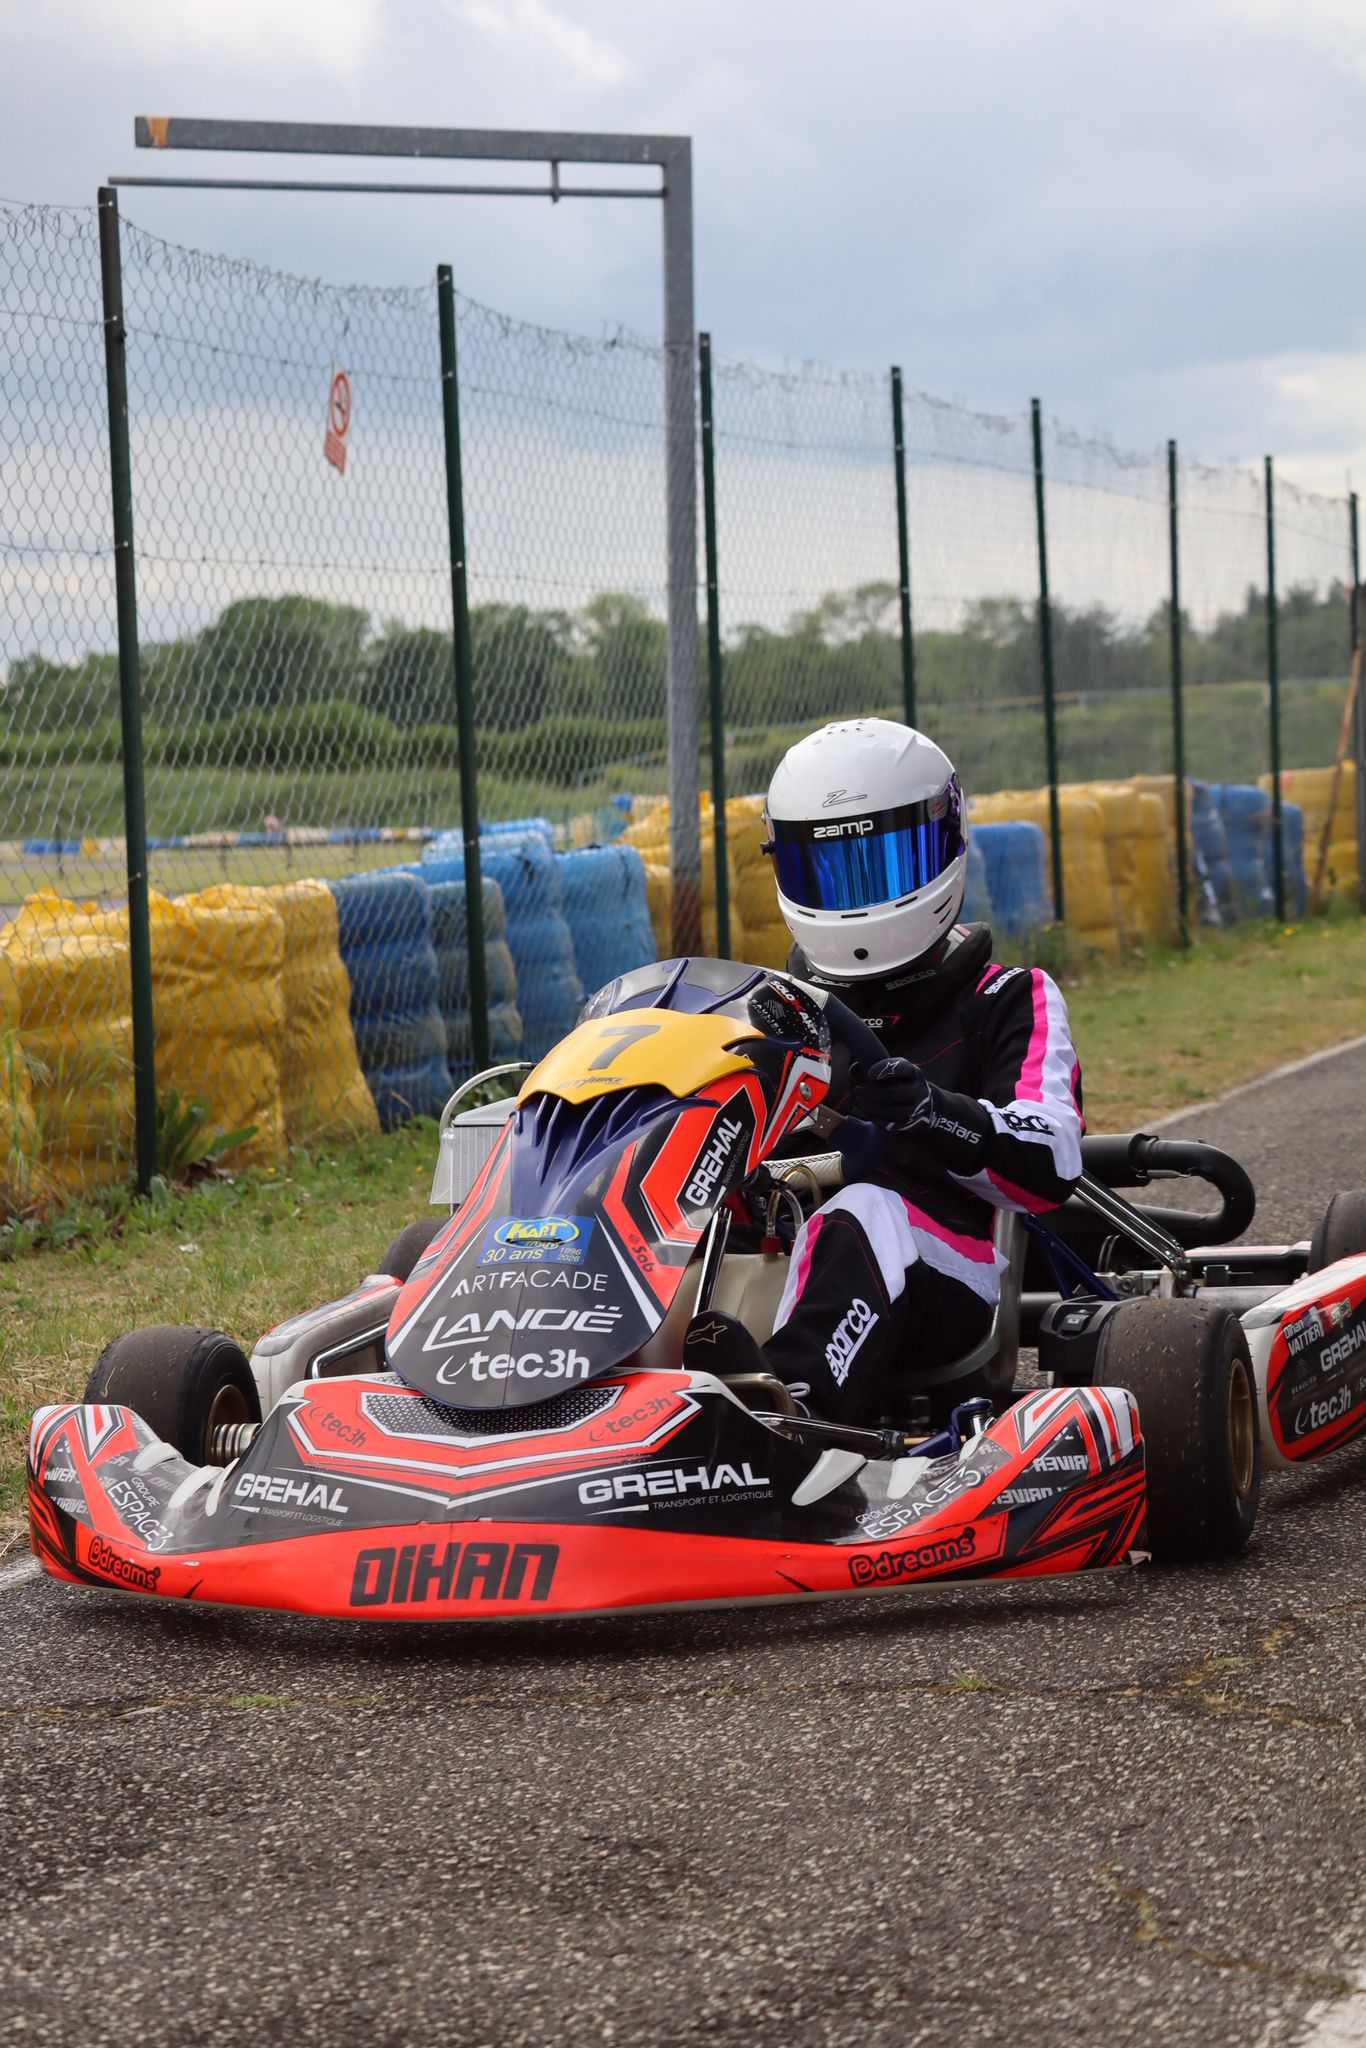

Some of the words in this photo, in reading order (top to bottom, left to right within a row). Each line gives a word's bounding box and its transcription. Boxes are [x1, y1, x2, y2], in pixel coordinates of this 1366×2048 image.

[813, 819, 874, 839] zamp
[588, 1024, 661, 1070] 7
[685, 1117, 743, 1207] GREHAL
[482, 1247, 506, 1264] 30
[509, 1248, 544, 1261] ans
[560, 1247, 582, 1255] 1996
[451, 1269, 608, 1298] ARTFACADE
[824, 1298, 880, 1387] sparco
[1288, 1323, 1321, 1357] VATTIER
[469, 1349, 590, 1382] tec3h
[605, 1395, 673, 1433] tec3h
[1310, 1384, 1352, 1429] tec3h
[321, 1411, 367, 1449] tec3h
[131, 1476, 160, 1507] GROUPE
[234, 1473, 349, 1513] GREHAL
[578, 1462, 770, 1505] GREHAL
[653, 1497, 707, 1510] TRANSPORT
[708, 1494, 719, 1504] ET
[721, 1490, 774, 1503] LOGISTIQUE
[261, 1507, 295, 1519] TRANSPORT
[302, 1513, 344, 1526] LOGISTIQUE
[855, 1501, 903, 1524] GROUPE
